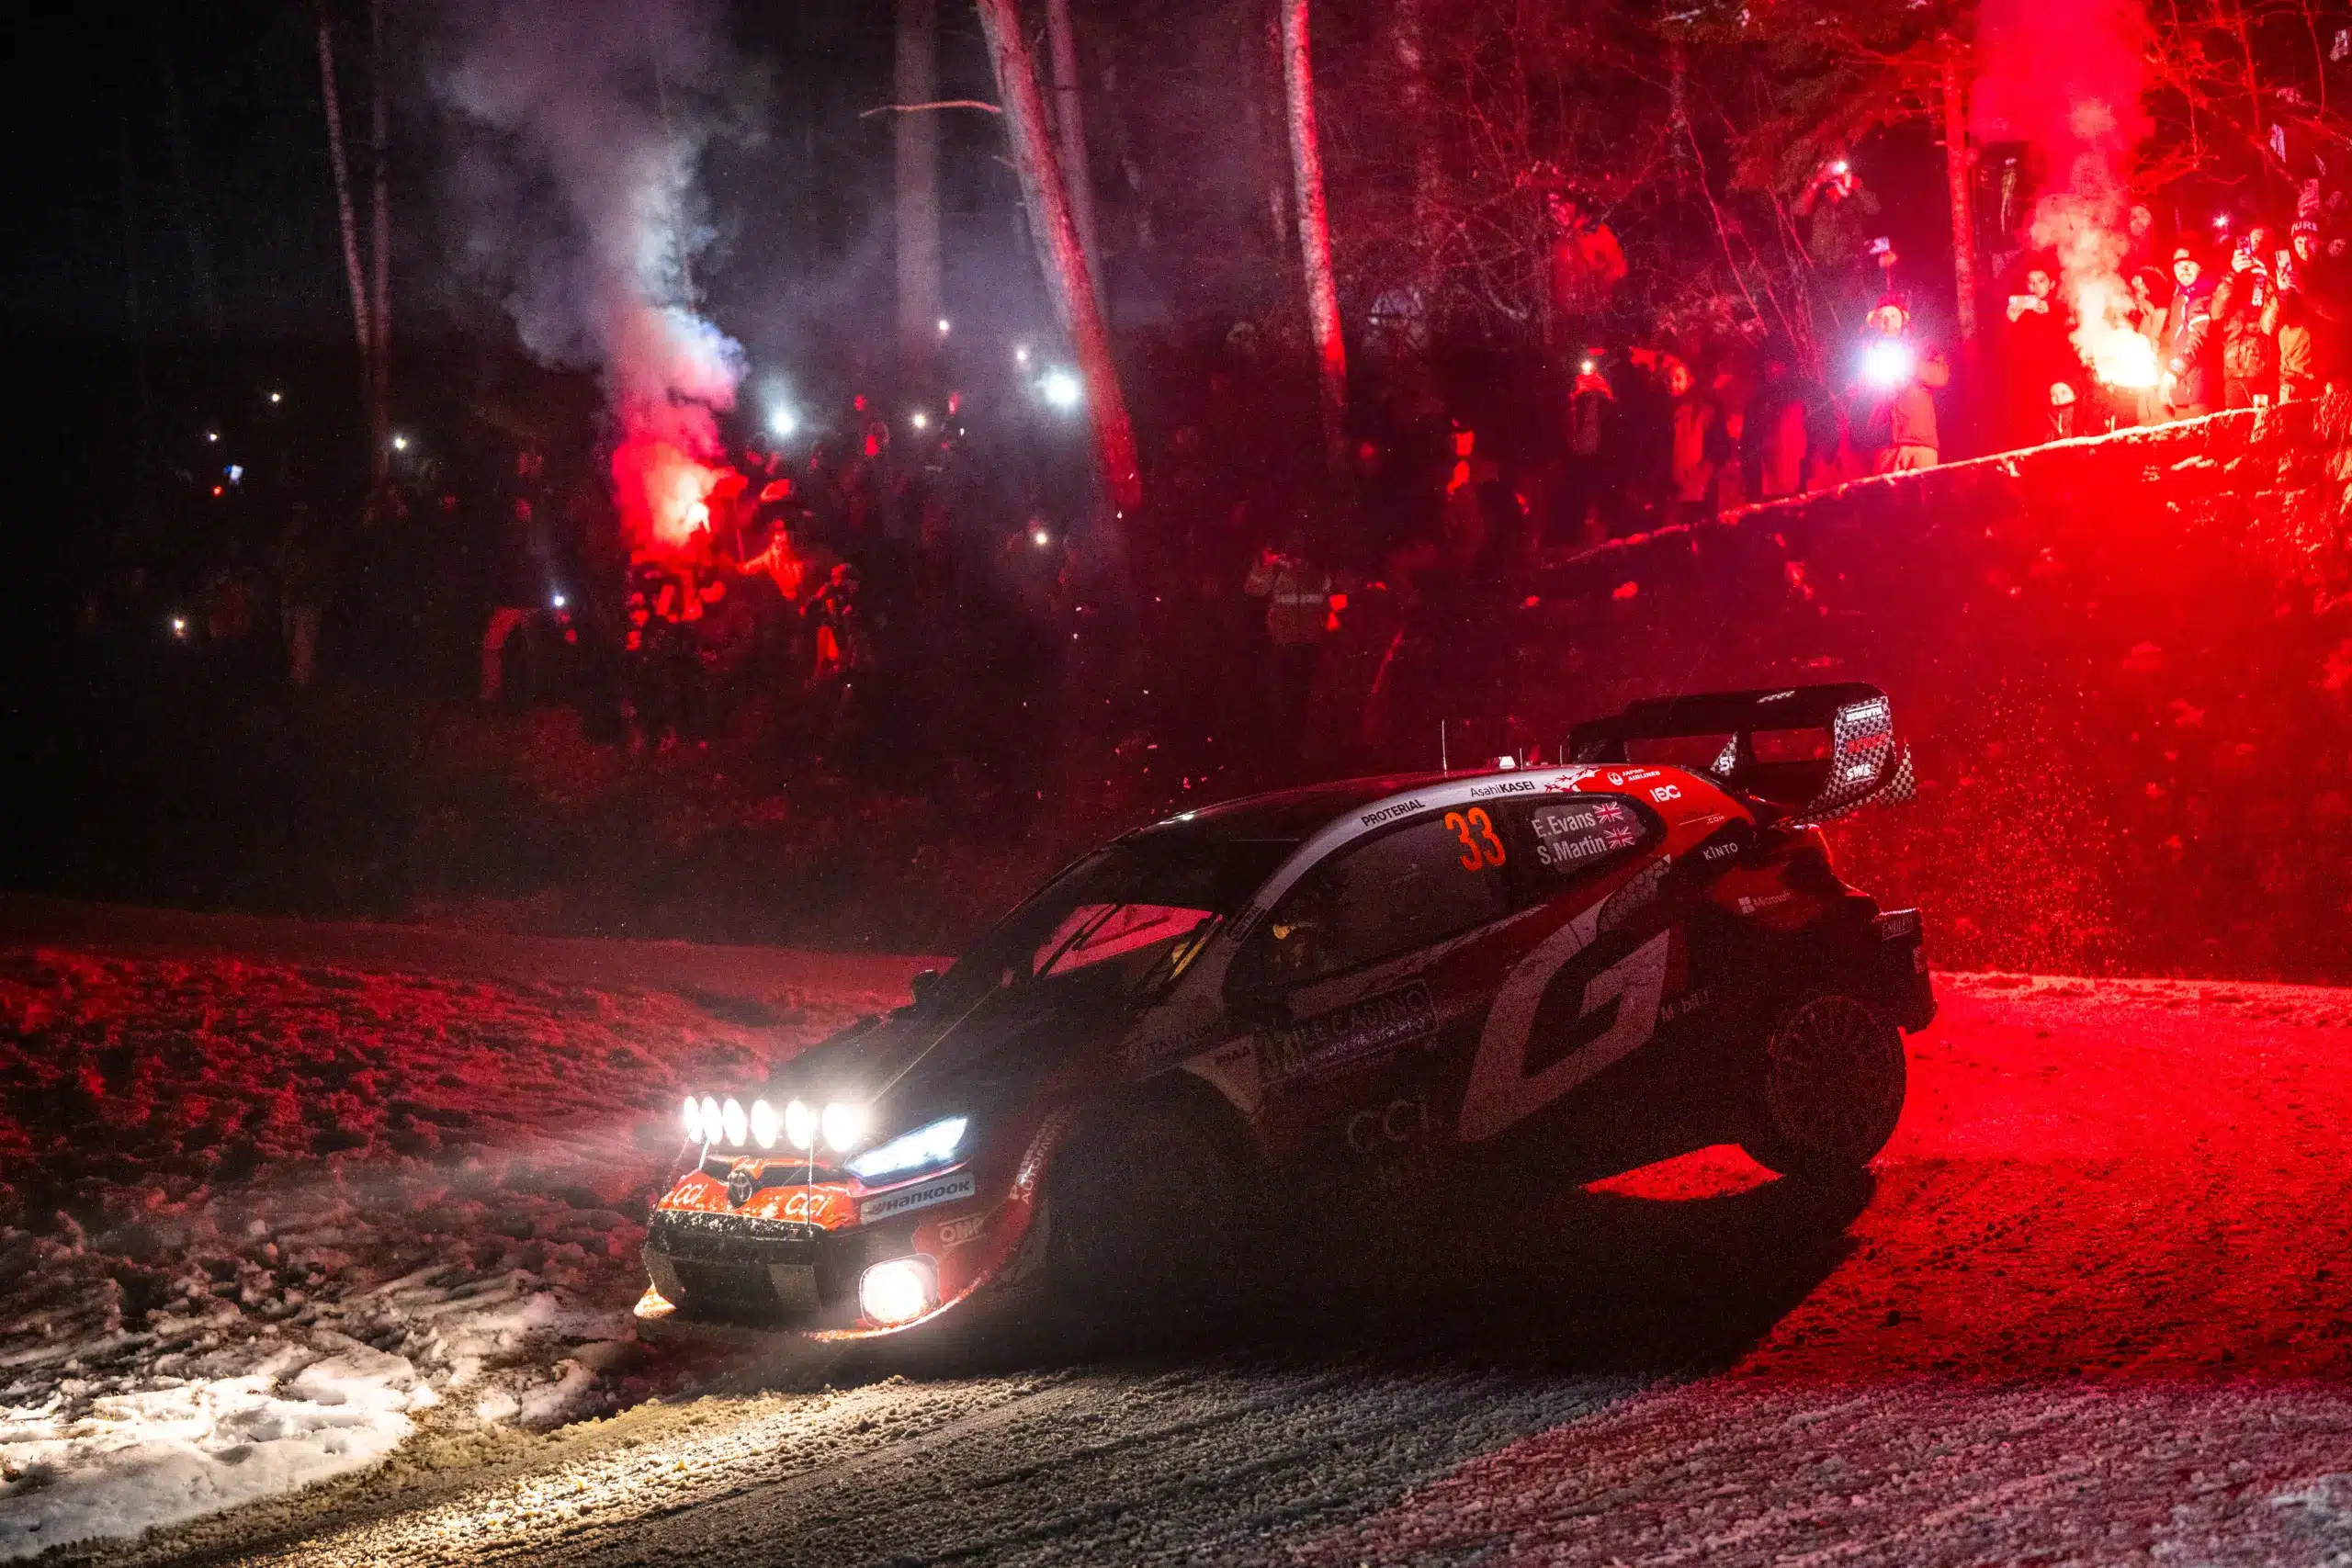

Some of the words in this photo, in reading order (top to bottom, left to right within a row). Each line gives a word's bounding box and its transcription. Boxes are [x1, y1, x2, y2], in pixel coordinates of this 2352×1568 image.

[1621, 768, 1645, 778] JAPAN
[1628, 770, 1661, 782] AIRLINES
[1470, 781, 1535, 797] AsahiKASEI
[1360, 798, 1426, 828] PROTERIAL
[1531, 811, 1597, 840] E.Evans
[1444, 807, 1507, 872] 33
[1536, 834, 1608, 866] S.Martin
[1752, 889, 1793, 908] Microsoft
[673, 1183, 708, 1206] CCI
[785, 1193, 832, 1217] CCI
